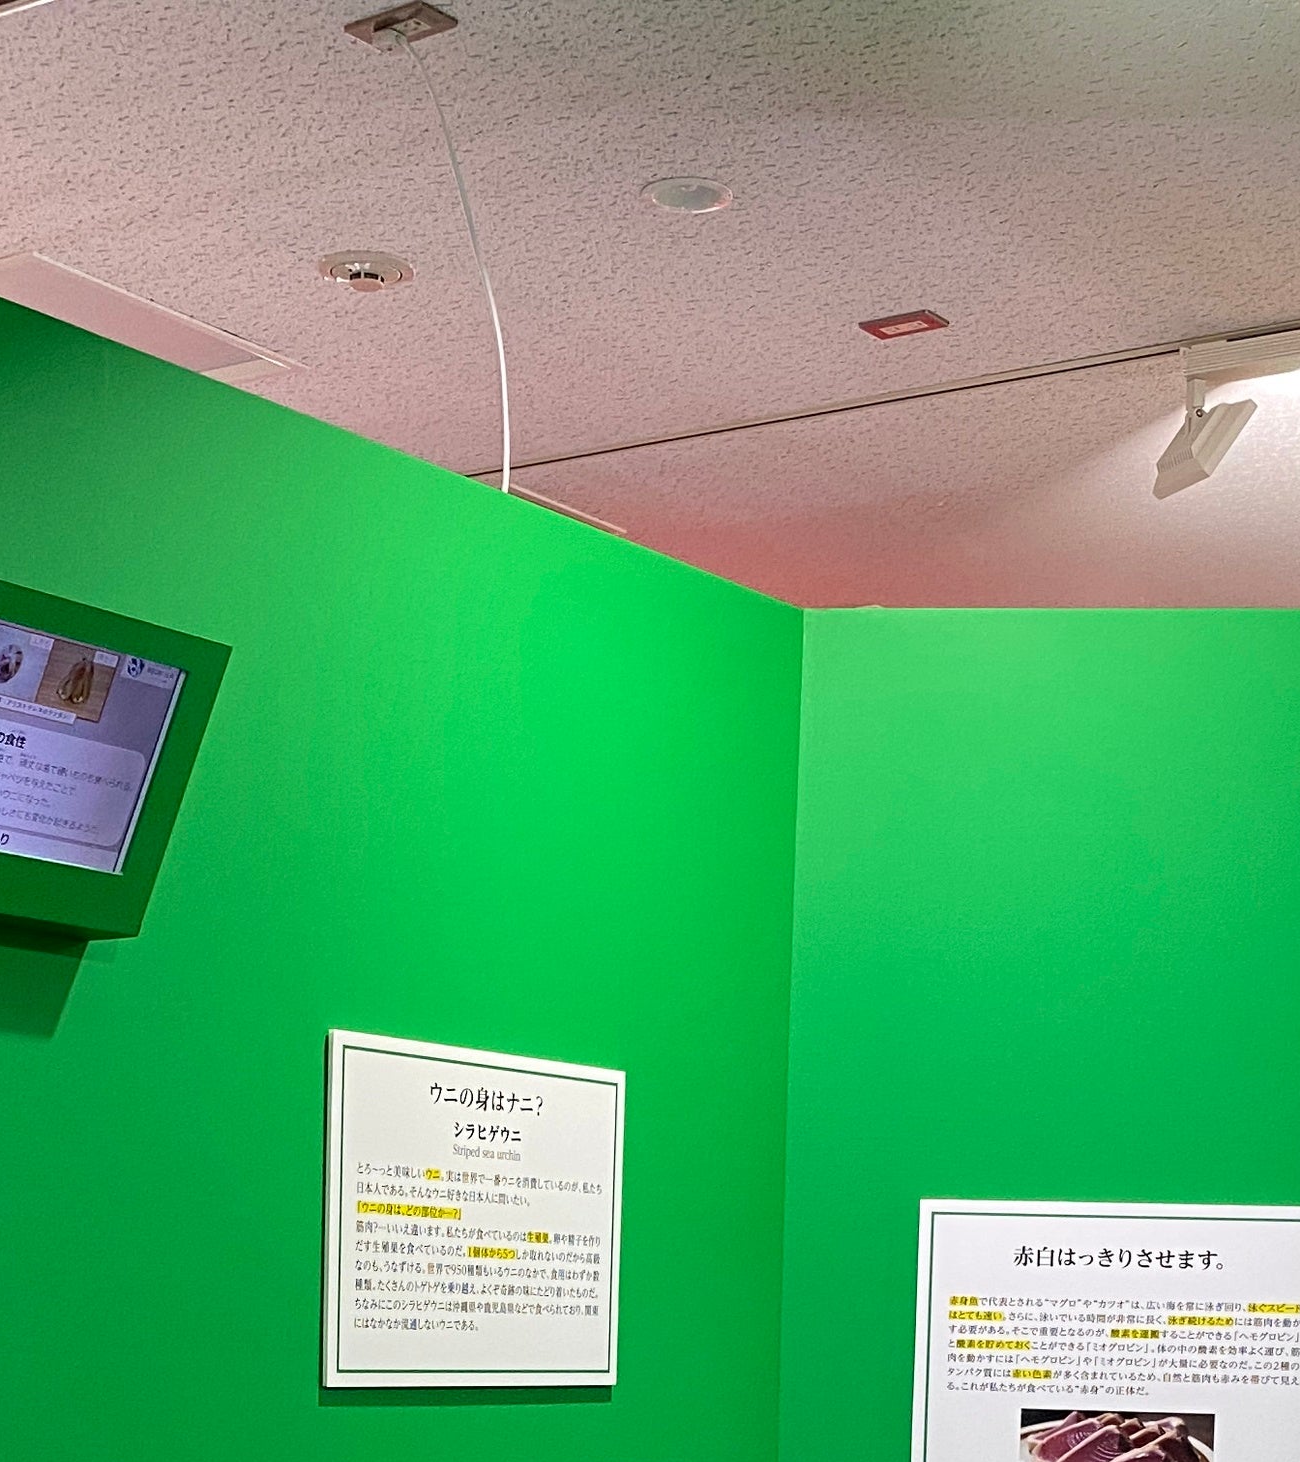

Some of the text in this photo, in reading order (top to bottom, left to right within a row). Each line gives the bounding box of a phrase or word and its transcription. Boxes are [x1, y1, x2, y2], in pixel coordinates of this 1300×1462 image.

[430, 1082, 544, 1117] ウニの身はナニ?
[453, 1121, 522, 1144] シラヒゲウニ
[452, 1143, 522, 1162] Striped sea urchin
[1013, 1245, 1224, 1271] 赤白はっきりさせます。
